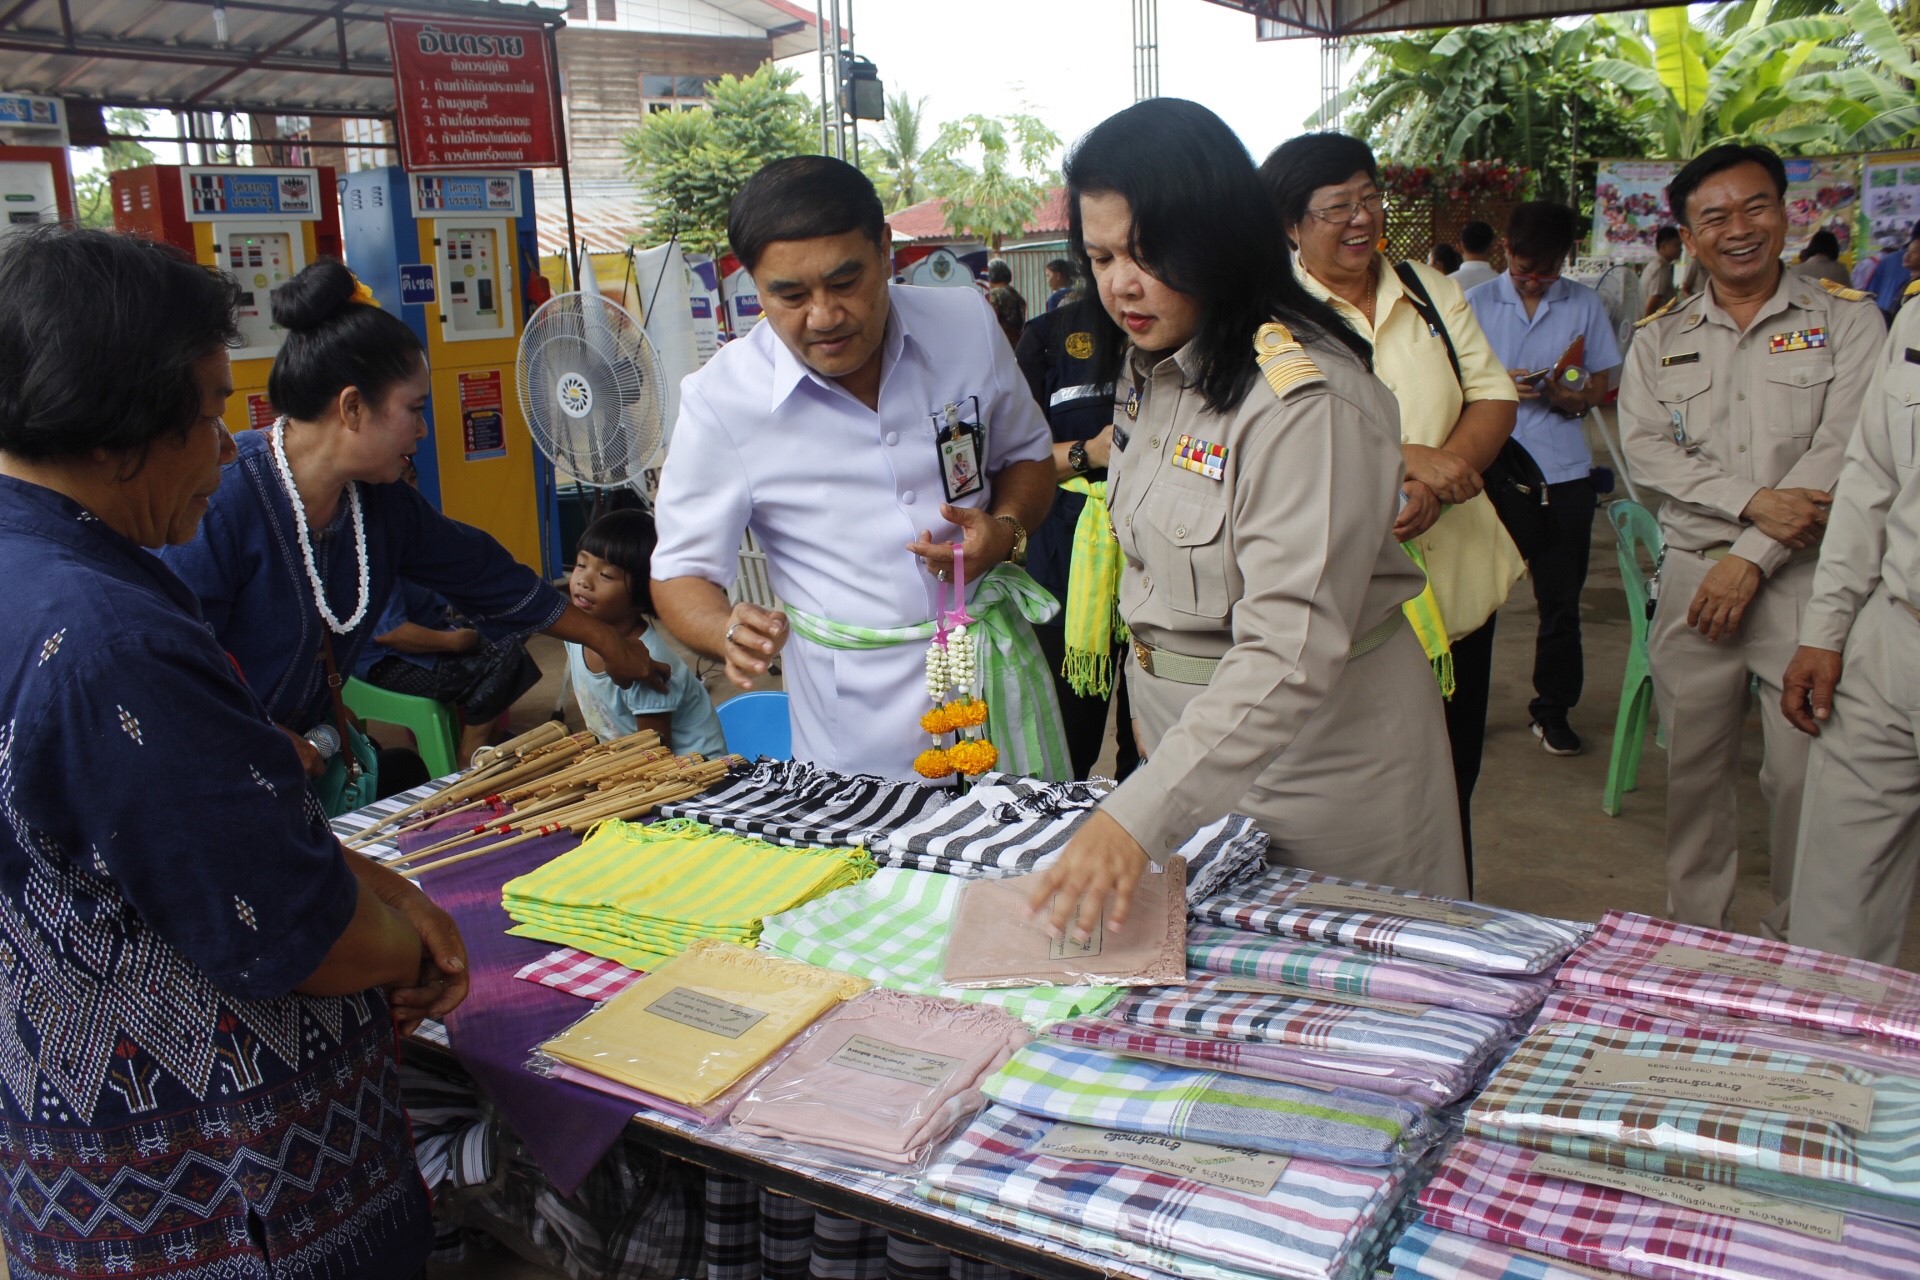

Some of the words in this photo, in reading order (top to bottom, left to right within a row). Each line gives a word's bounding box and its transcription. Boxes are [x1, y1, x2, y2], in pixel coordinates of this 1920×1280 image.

[417, 25, 524, 58] อันตราย
[420, 80, 430, 91] 1.
[421, 97, 432, 109] 2.
[423, 115, 434, 127] 3.
[426, 133, 437, 144] 4.
[429, 151, 440, 161] 5.
[229, 175, 271, 192] โครงการ
[402, 274, 434, 290] ดีเซล
[1104, 1132, 1181, 1151] ผ้าขาวม้าทอมือ
